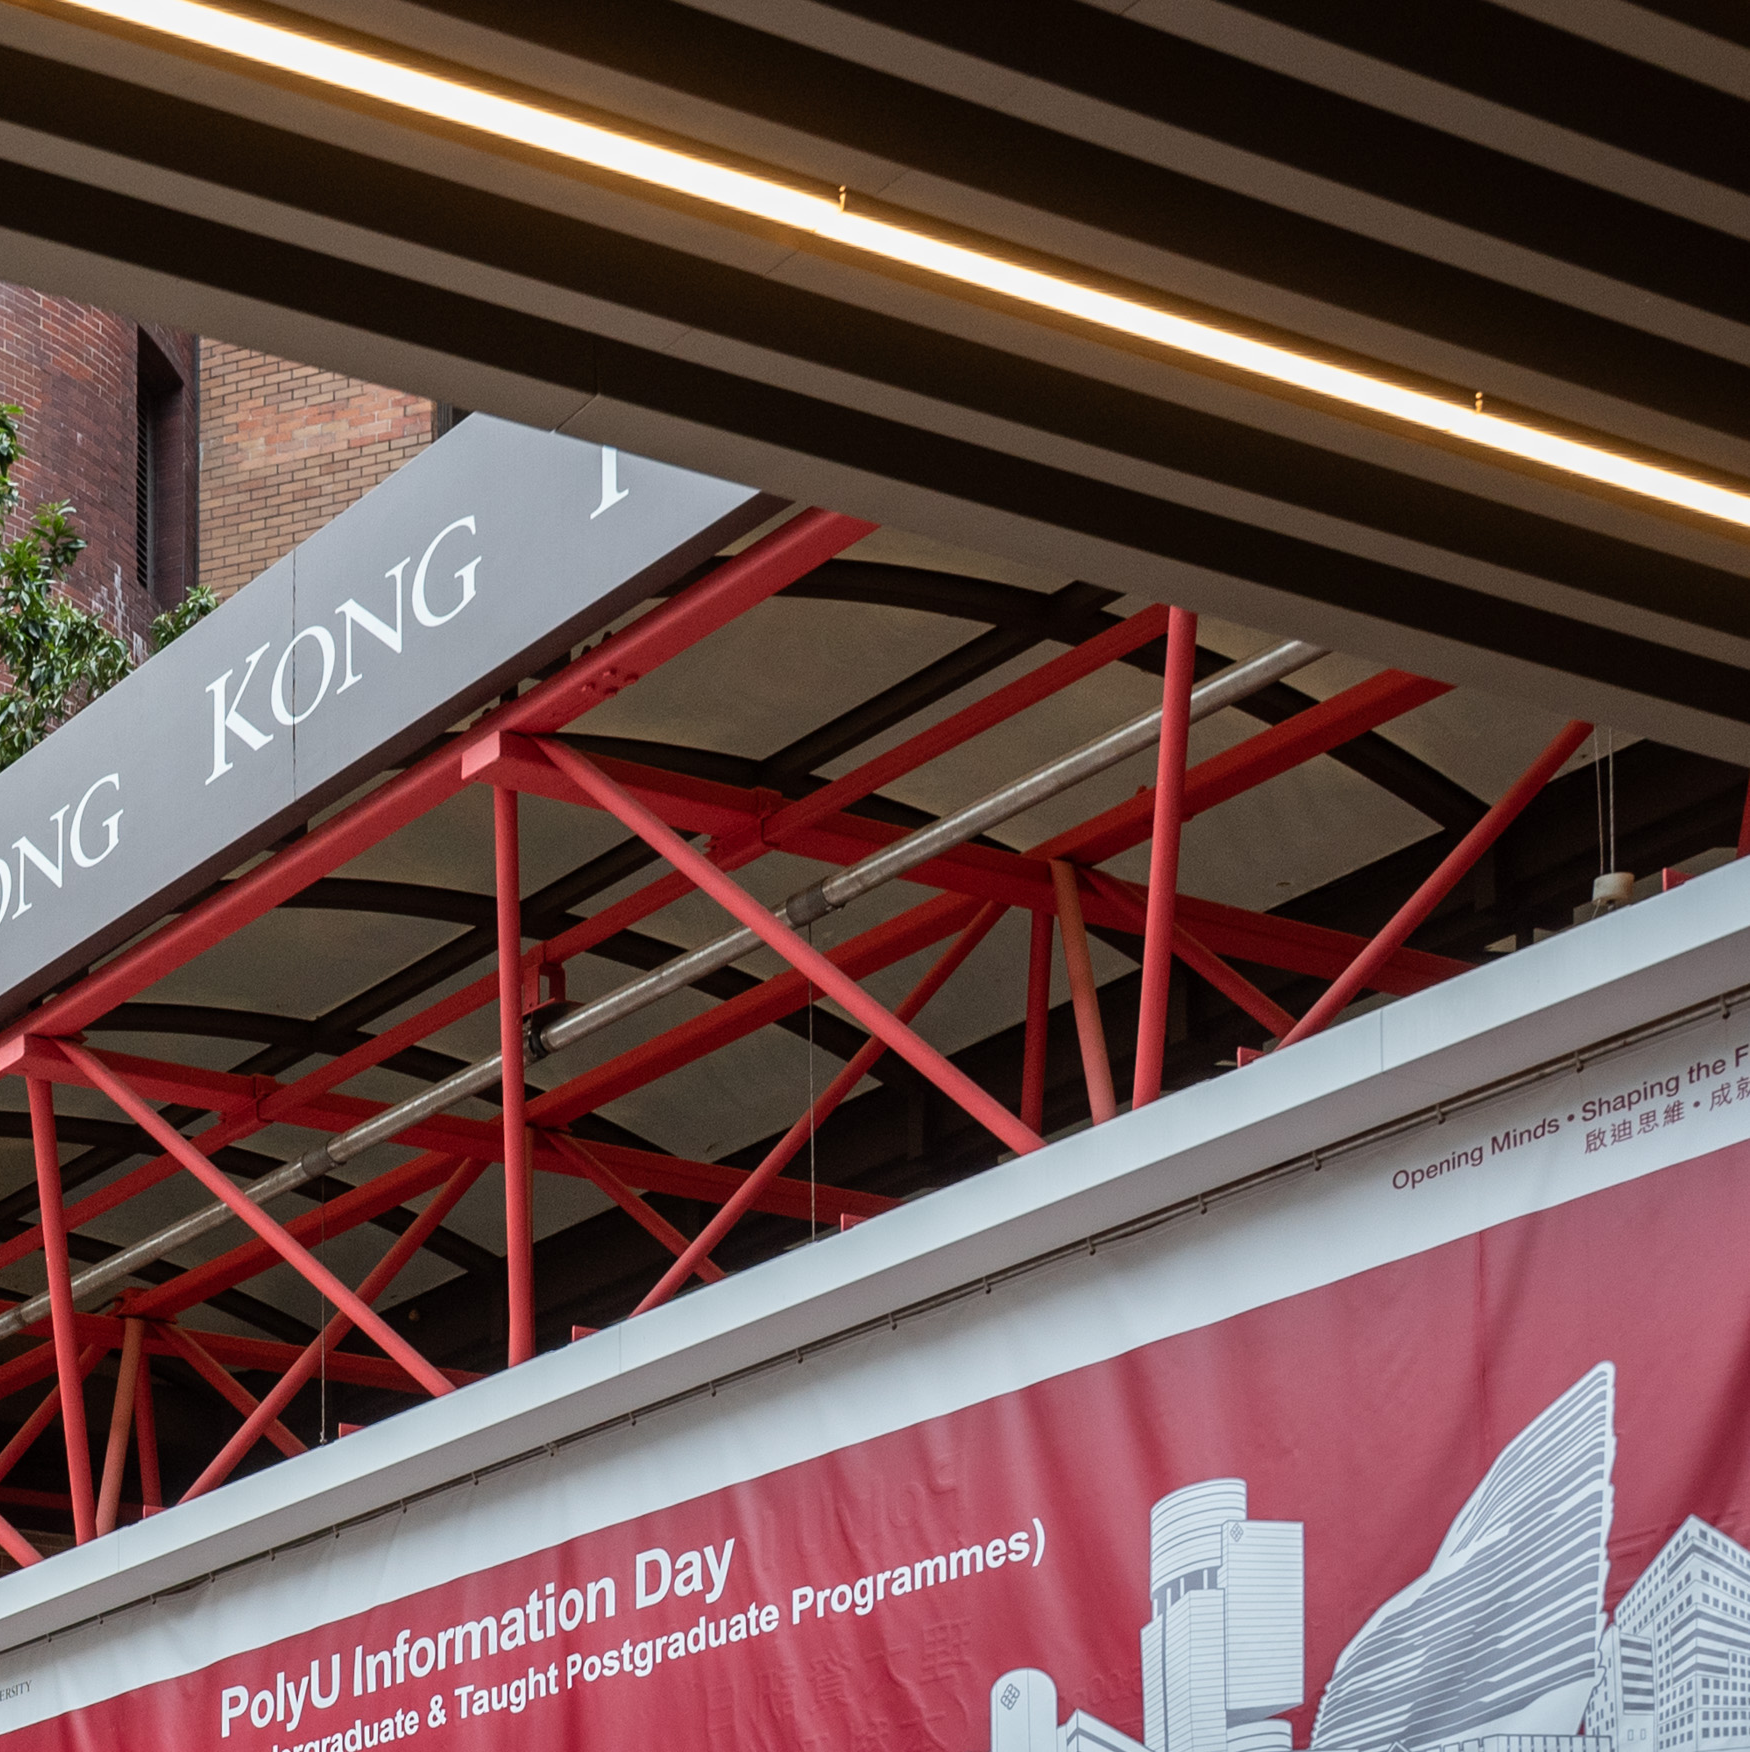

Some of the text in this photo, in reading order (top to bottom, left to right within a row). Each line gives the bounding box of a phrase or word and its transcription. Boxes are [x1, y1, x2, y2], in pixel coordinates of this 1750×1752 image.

[206, 515, 483, 786] KONG
[1392, 1143, 1484, 1190] Opening
[1491, 1115, 1560, 1155] Minds
[1581, 1074, 1680, 1122] Shaping
[1688, 1058, 1727, 1084] the
[1584, 1099, 1685, 1154] 啟迪思維
[220, 1537, 737, 1740] PolyU Information Day
[427, 1692, 447, 1727] &
[454, 1660, 558, 1733] Taught
[566, 1597, 781, 1704] Postgraduate
[791, 1516, 1047, 1638] Programmes)
